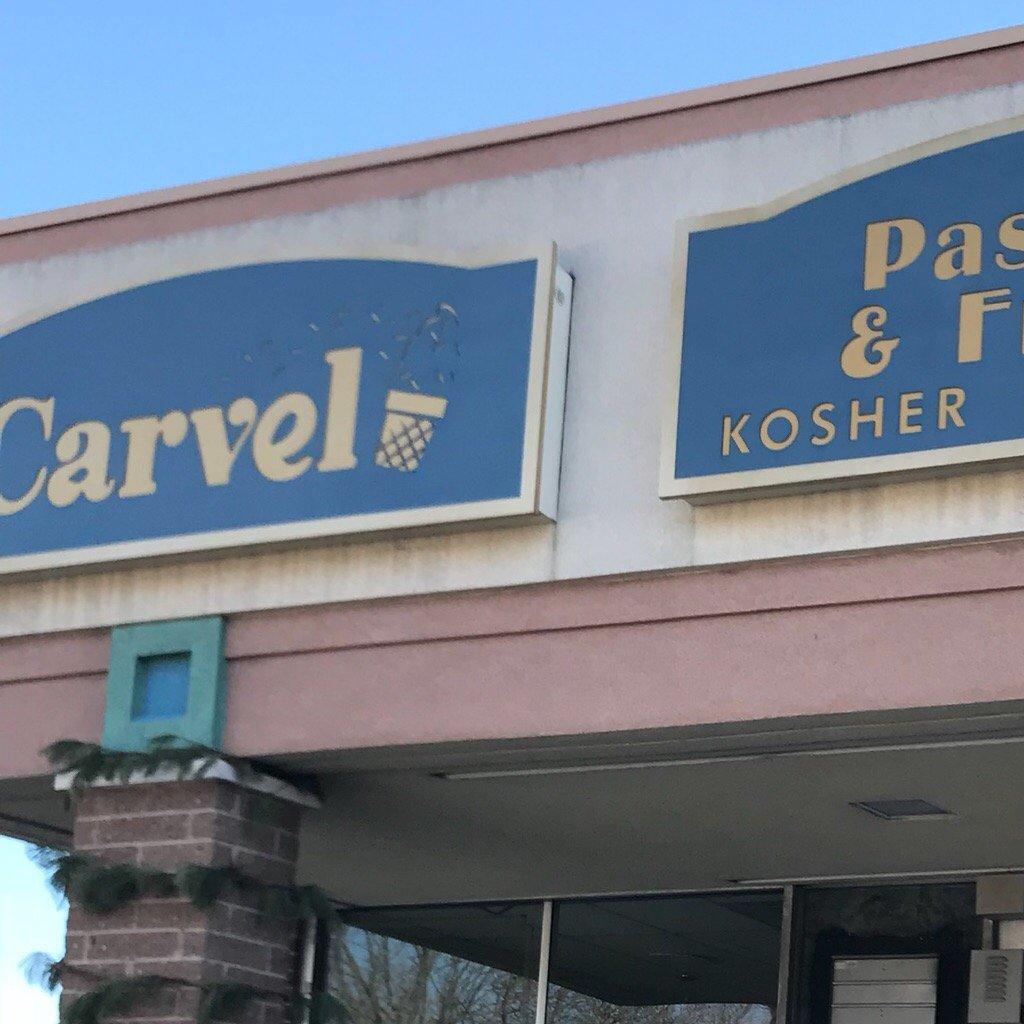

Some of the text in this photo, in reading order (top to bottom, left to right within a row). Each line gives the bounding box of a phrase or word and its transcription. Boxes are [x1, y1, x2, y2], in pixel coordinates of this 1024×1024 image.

[839, 305, 900, 379] &
[0, 347, 363, 515] Carvel
[721, 387, 967, 456] KOSHER
